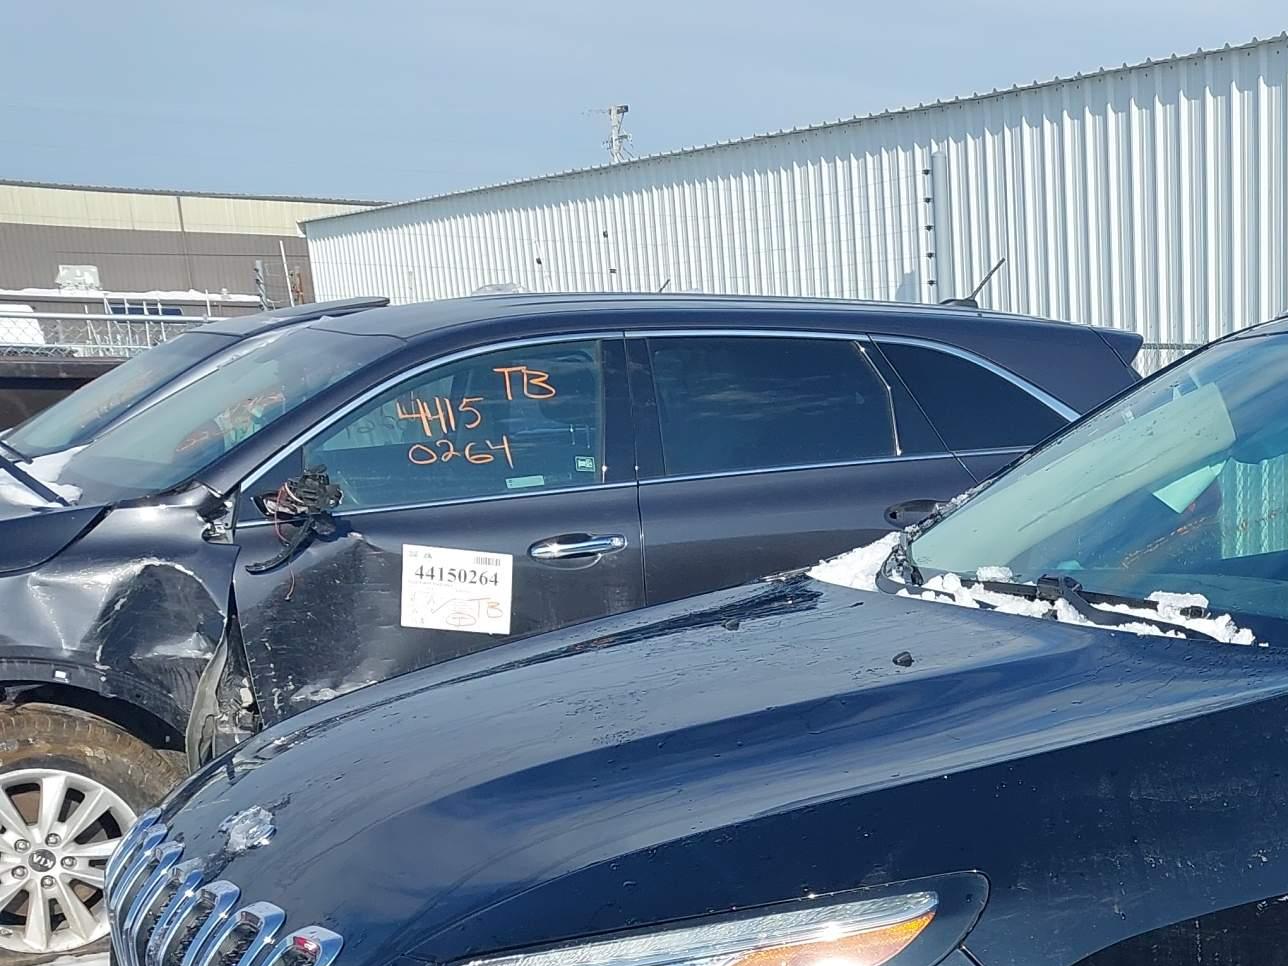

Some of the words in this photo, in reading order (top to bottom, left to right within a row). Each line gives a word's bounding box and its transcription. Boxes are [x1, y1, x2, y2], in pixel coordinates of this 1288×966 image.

[493, 366, 556, 399] TB
[396, 397, 484, 437] 4415
[408, 434, 514, 470] 0264
[415, 565, 499, 586] 44150264
